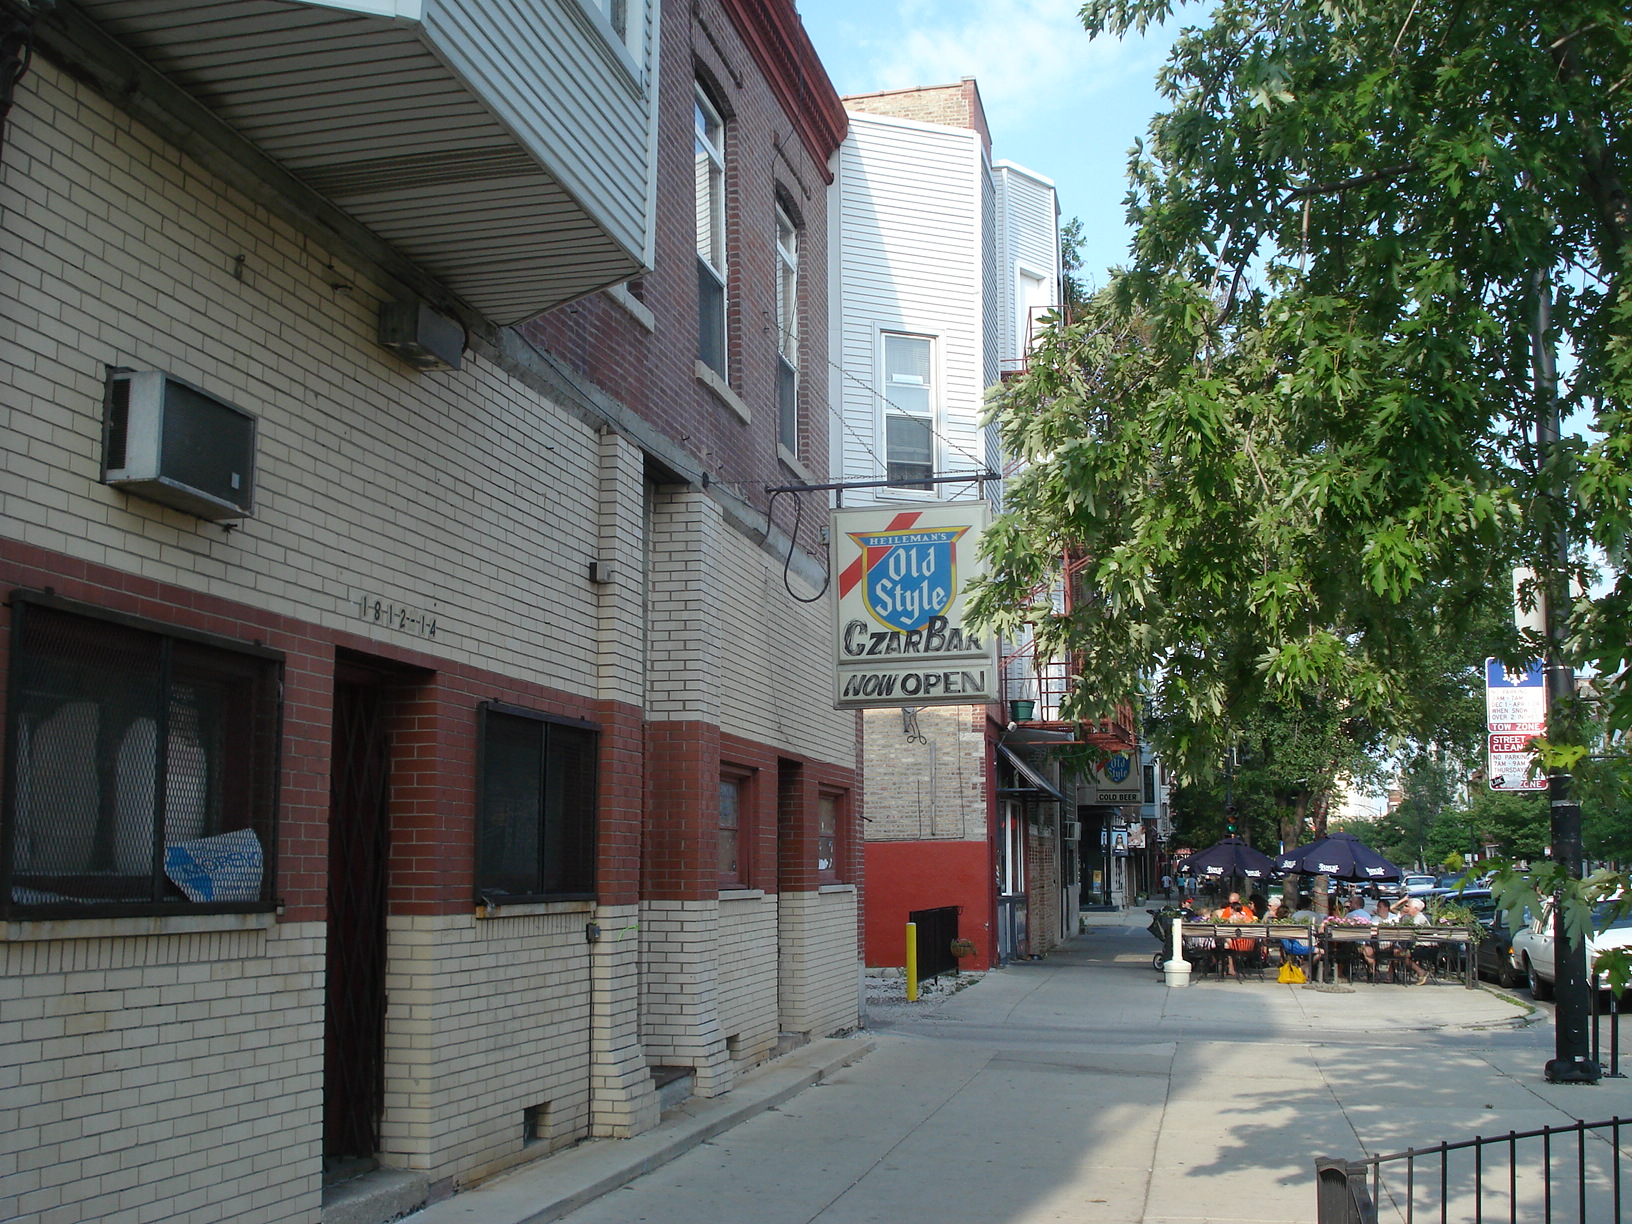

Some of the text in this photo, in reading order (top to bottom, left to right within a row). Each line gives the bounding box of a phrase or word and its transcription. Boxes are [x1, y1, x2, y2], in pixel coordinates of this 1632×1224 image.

[869, 532, 948, 546] HEILEMAN'S
[888, 546, 936, 581] Old
[875, 578, 946, 625] Style
[843, 670, 985, 697] NOW OPEN
[1492, 723, 1512, 731] TOW
[1492, 735, 1526, 743] STREET
[1099, 793, 1137, 801] COLD BEER
